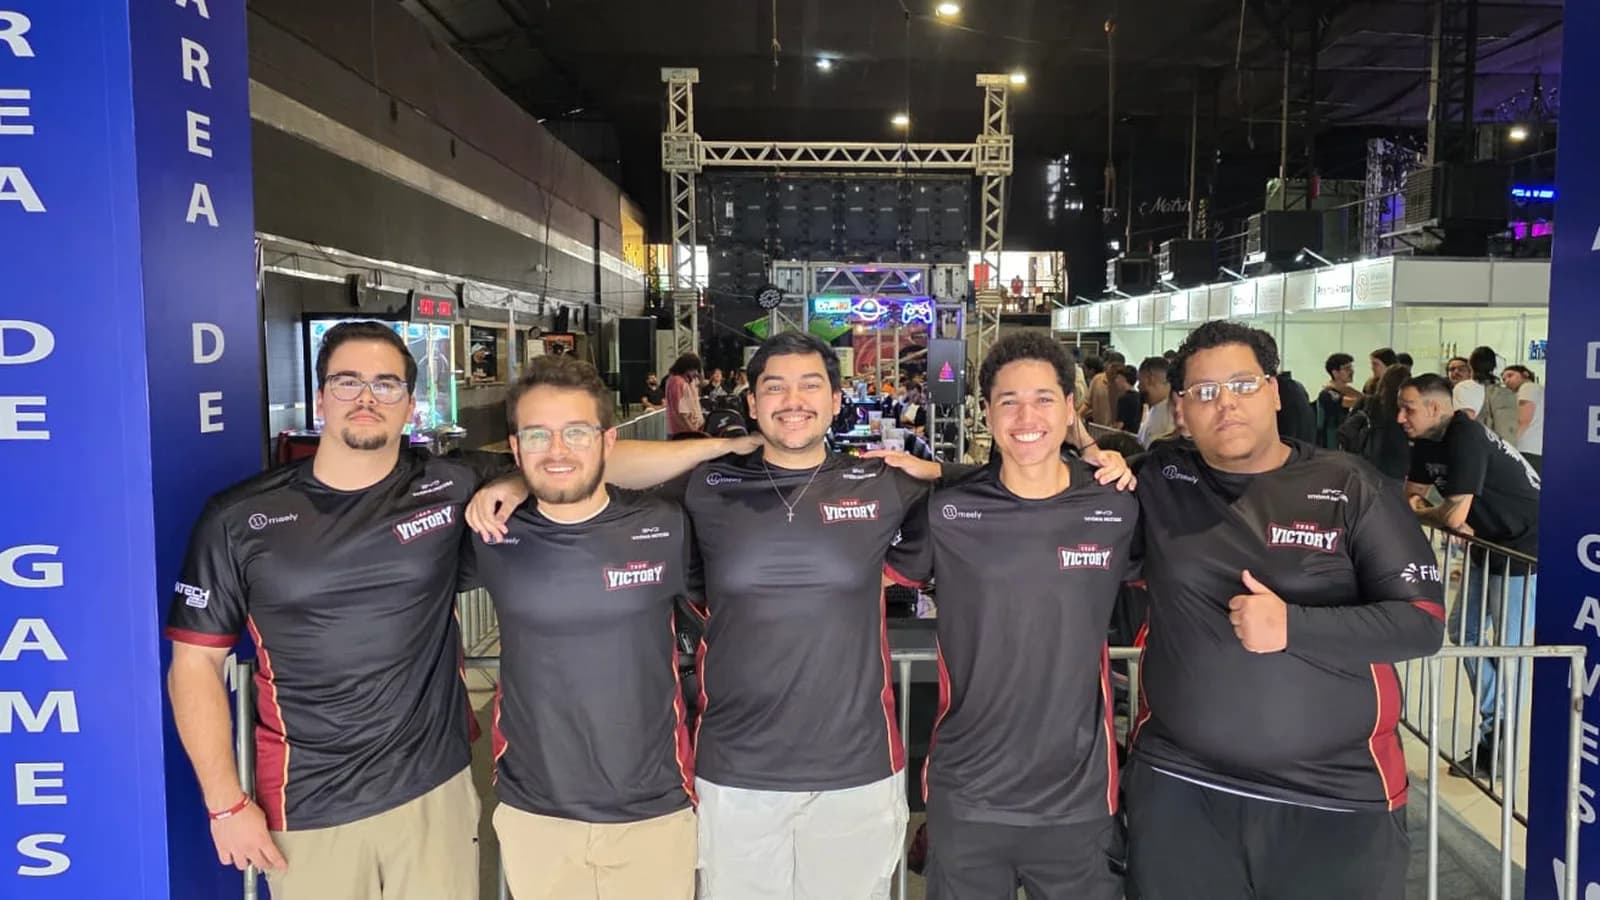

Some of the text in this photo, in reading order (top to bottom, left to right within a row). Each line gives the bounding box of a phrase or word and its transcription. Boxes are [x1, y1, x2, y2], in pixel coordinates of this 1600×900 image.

[0, 320, 55, 440] DE
[192, 322, 225, 433] DE
[397, 506, 451, 540] VICTORY
[824, 503, 876, 520] VICTORY
[1271, 527, 1337, 550] VICTORY
[1062, 550, 1111, 567] VICTORY
[608, 565, 663, 587] VICTORY
[0, 545, 80, 876] GAMES
